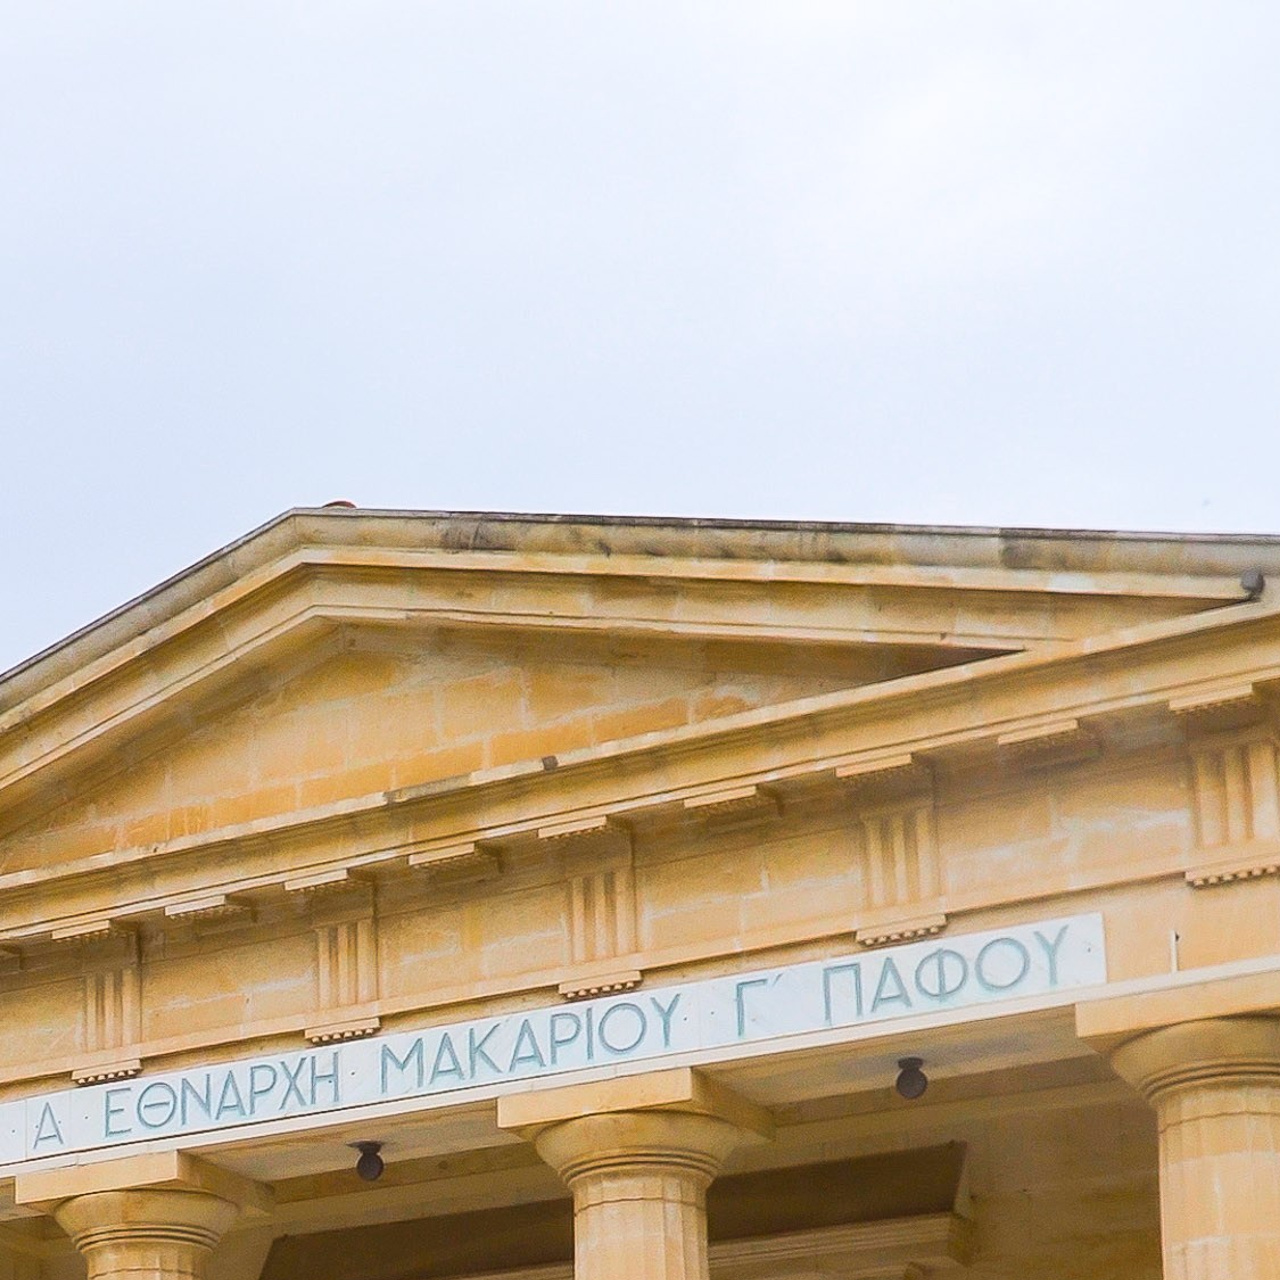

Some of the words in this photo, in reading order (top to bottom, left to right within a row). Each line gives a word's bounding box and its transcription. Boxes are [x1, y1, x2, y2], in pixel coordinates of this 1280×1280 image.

[32, 1102, 65, 1149] Α
[105, 1052, 340, 1137] ΕΘΝΑΡΧΗ
[380, 993, 682, 1093] ΜΑΚΑΡΙΟΥ
[823, 925, 1070, 1023] ΠΑΦΟΥ
